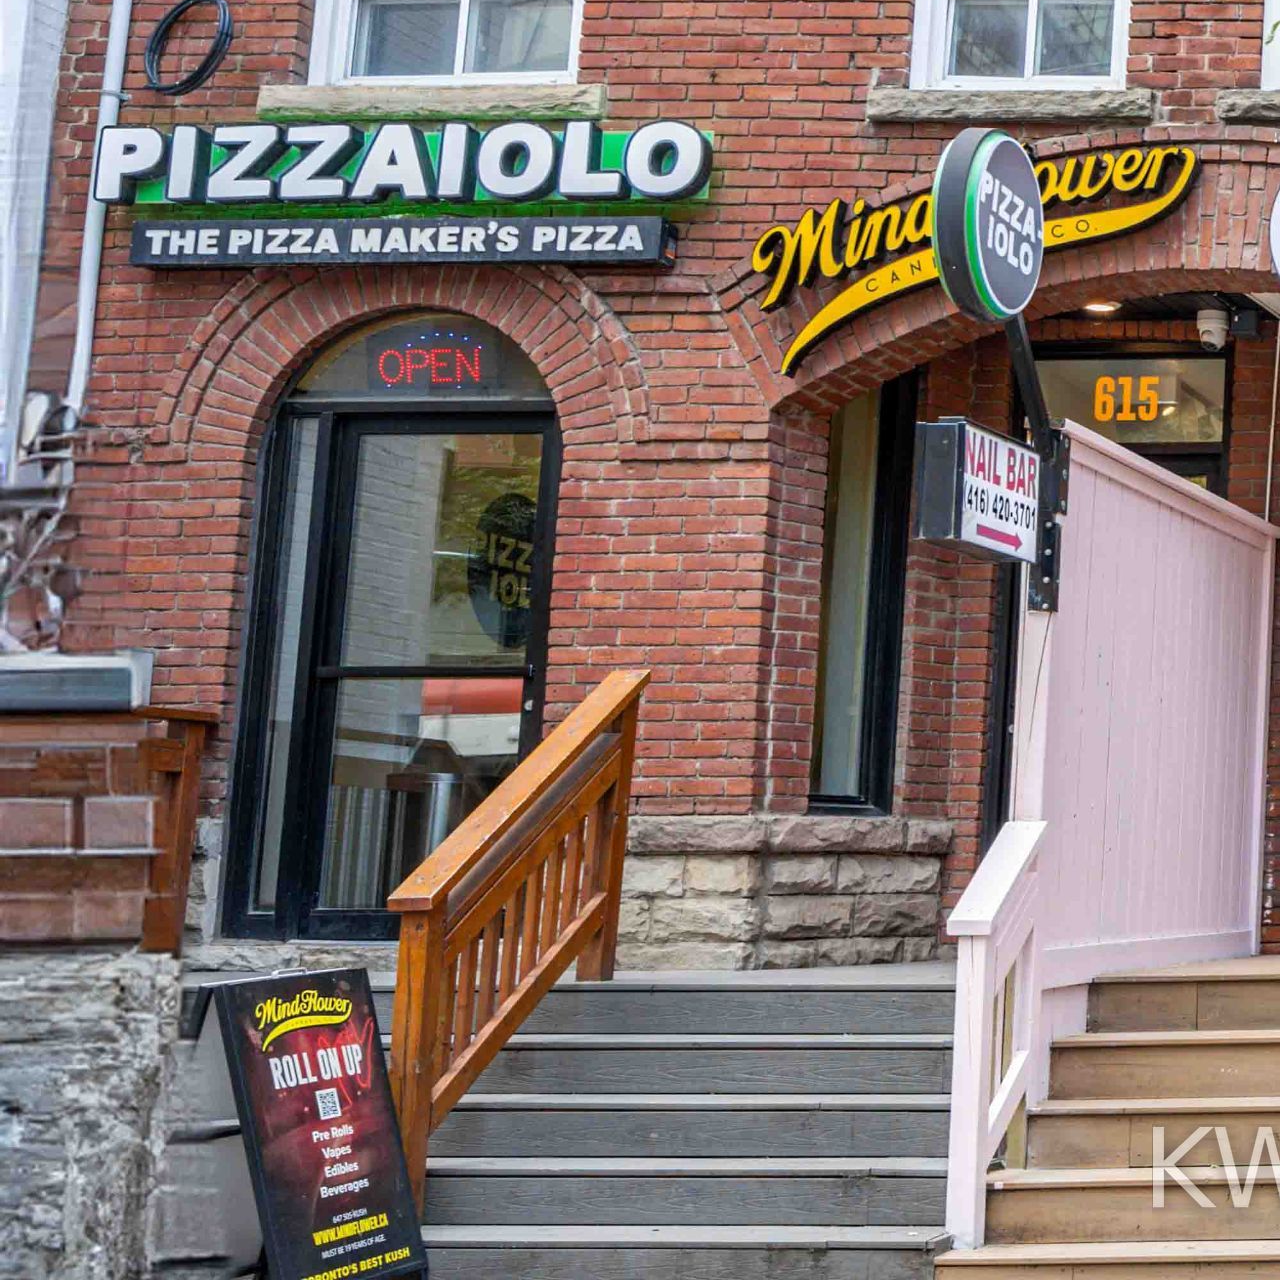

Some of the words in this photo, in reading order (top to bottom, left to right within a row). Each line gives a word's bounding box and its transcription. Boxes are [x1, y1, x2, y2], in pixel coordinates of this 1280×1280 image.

[95, 122, 712, 203] PIZZAIOLO
[145, 230, 219, 256] THE
[228, 228, 339, 255] PIZZA
[350, 221, 519, 254] MAKER'S
[532, 225, 645, 252] PIZZA
[987, 214, 1034, 276] IOLO
[378, 347, 482, 384] OPEN
[1093, 375, 1160, 422] 615
[964, 428, 1002, 486] NAIL
[1006, 447, 1037, 501] BAR
[963, 481, 989, 516] (416)
[992, 493, 1036, 531] 420-3701
[255, 989, 353, 1030] MindFlower
[269, 1051, 318, 1090] ROLL
[316, 1047, 343, 1081] ON
[341, 1043, 363, 1076] UP
[312, 1131, 331, 1143] Pre
[330, 1124, 354, 1138] Rolls
[321, 1145, 352, 1160] Vapes
[320, 1178, 370, 1199] Beverages
[324, 1161, 359, 1178] Edibles
[360, 1255, 383, 1271] BEST
[385, 1247, 410, 1264] KUSH
